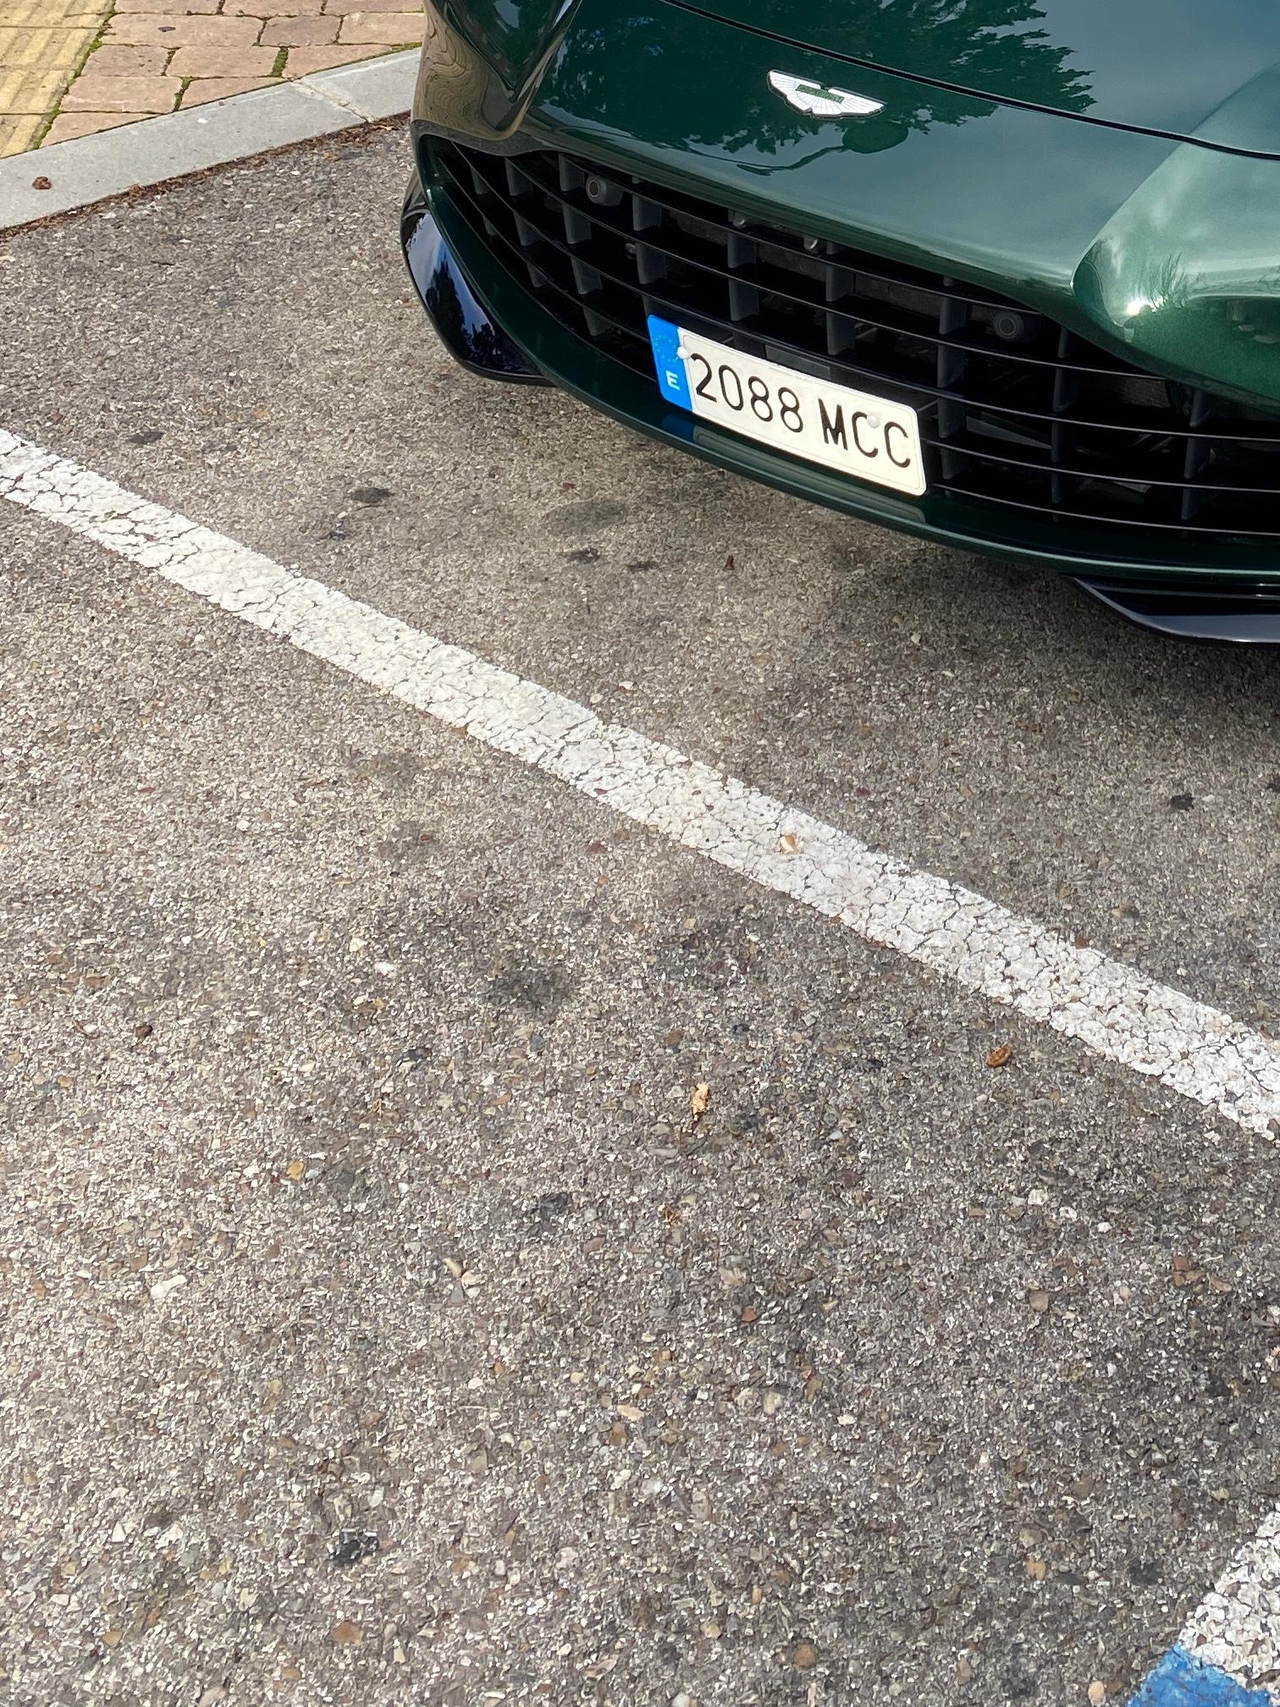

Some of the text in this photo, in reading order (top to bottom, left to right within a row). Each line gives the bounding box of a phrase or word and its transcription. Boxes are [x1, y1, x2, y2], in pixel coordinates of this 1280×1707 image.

[666, 369, 681, 391] E
[690, 352, 911, 469] 2088 MCC
